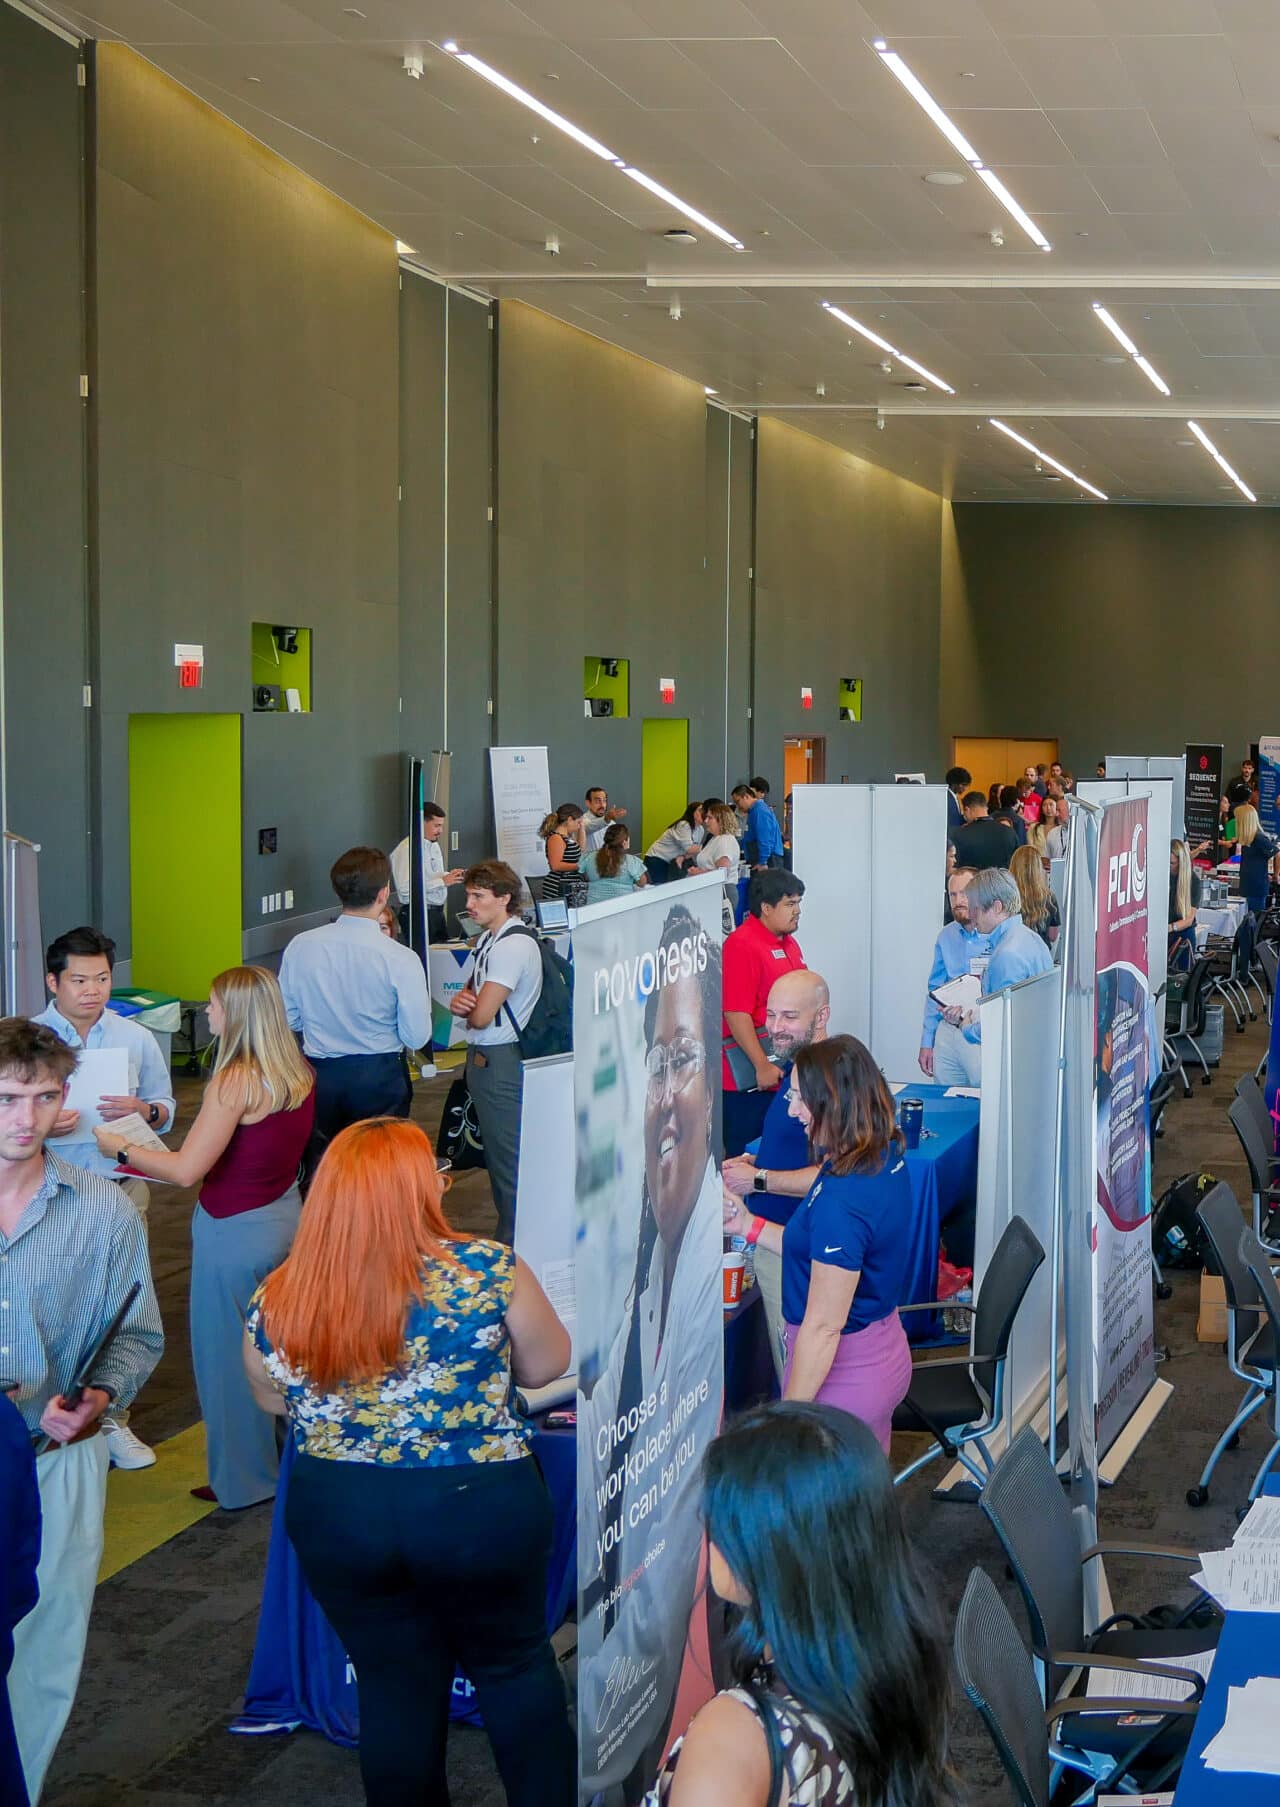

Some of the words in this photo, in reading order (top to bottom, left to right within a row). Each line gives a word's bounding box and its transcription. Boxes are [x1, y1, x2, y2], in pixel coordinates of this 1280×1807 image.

[1189, 773, 1217, 782] SEQUENCE
[1108, 850, 1132, 912] PCI
[594, 932, 707, 1015] novonesis
[597, 1391, 657, 1461] Choose
[660, 1380, 667, 1406] a
[597, 1422, 671, 1512] workplace
[672, 1380, 708, 1433] where
[597, 1514, 624, 1571] you
[629, 1484, 657, 1529] can
[661, 1462, 674, 1498] be
[675, 1433, 695, 1481] you
[597, 1599, 609, 1619] The
[644, 1539, 666, 1568] choice
